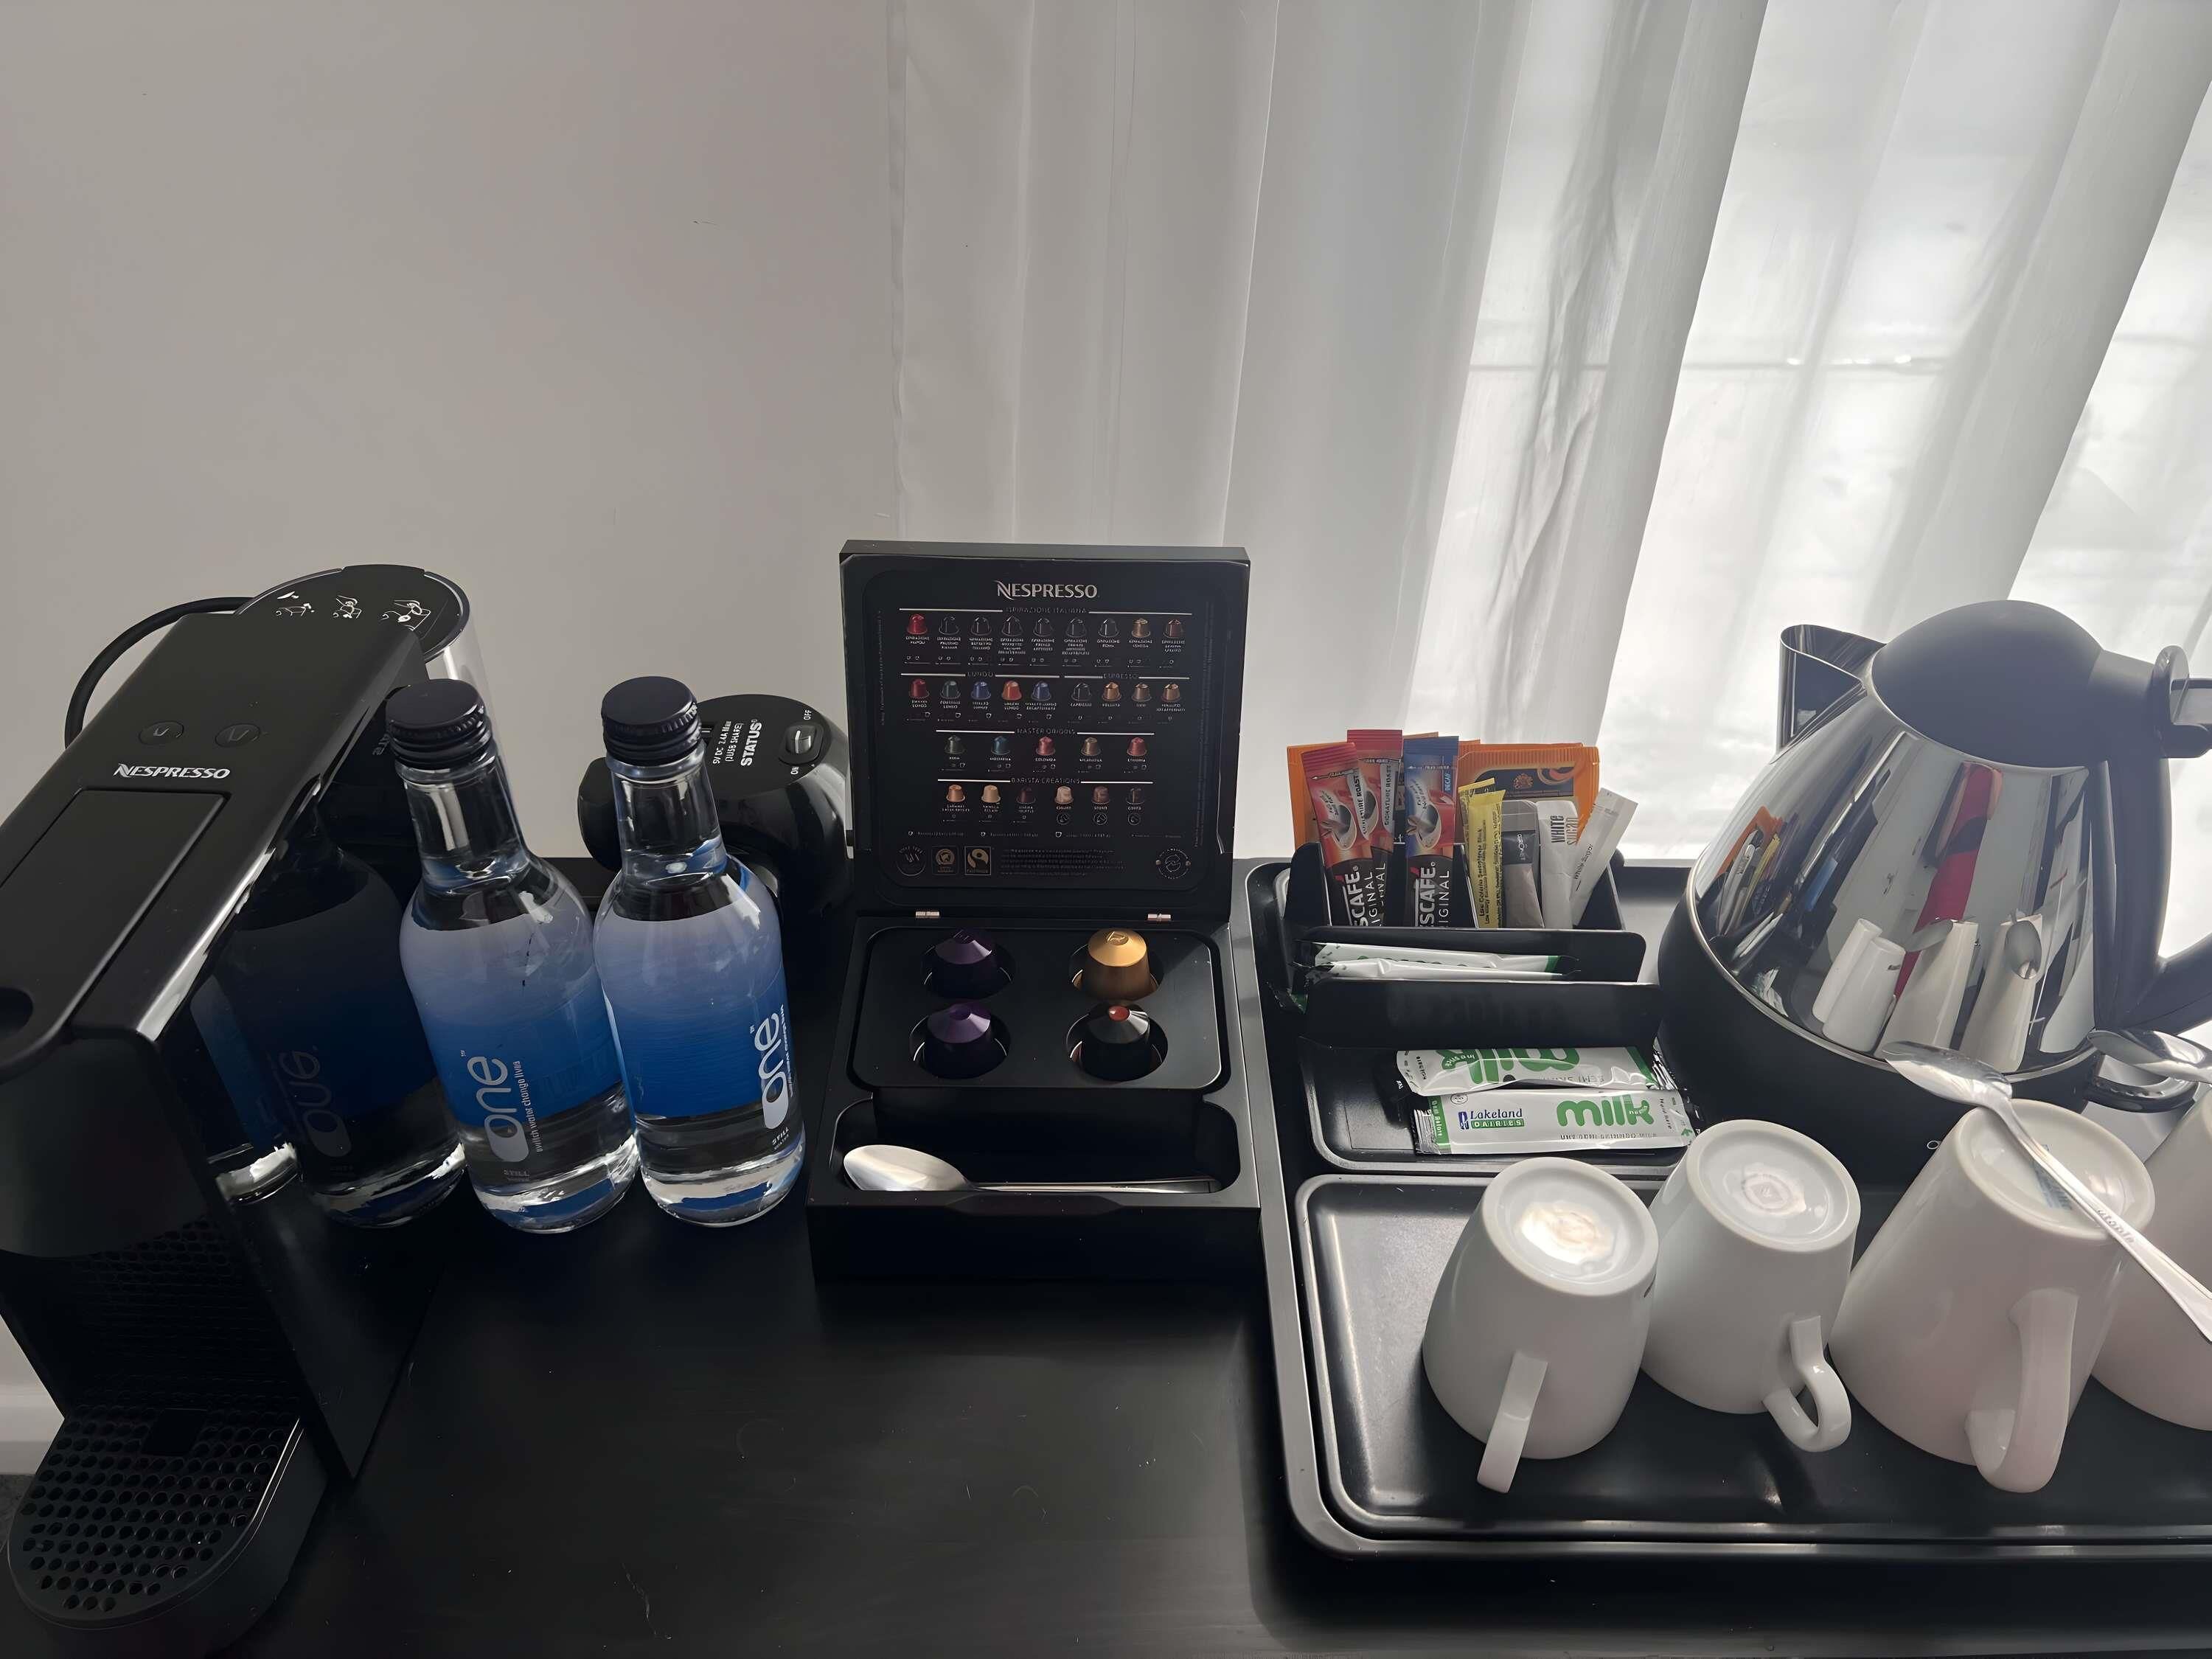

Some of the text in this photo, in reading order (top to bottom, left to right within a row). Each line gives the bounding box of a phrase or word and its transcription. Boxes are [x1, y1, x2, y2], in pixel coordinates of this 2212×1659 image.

[994, 579, 1099, 600] NESPRESSO
[803, 709, 813, 720] OFF
[740, 722, 762, 767] STATUS
[113, 762, 231, 779] NESPRESSO
[790, 766, 800, 775] ON
[1366, 872, 1383, 927] IGINAL
[1438, 870, 1450, 927] IGINAL
[754, 1012, 789, 1130] one
[467, 1056, 530, 1163] one
[1470, 1108, 1523, 1119] Lakeland
[1557, 1093, 1655, 1127] milk
